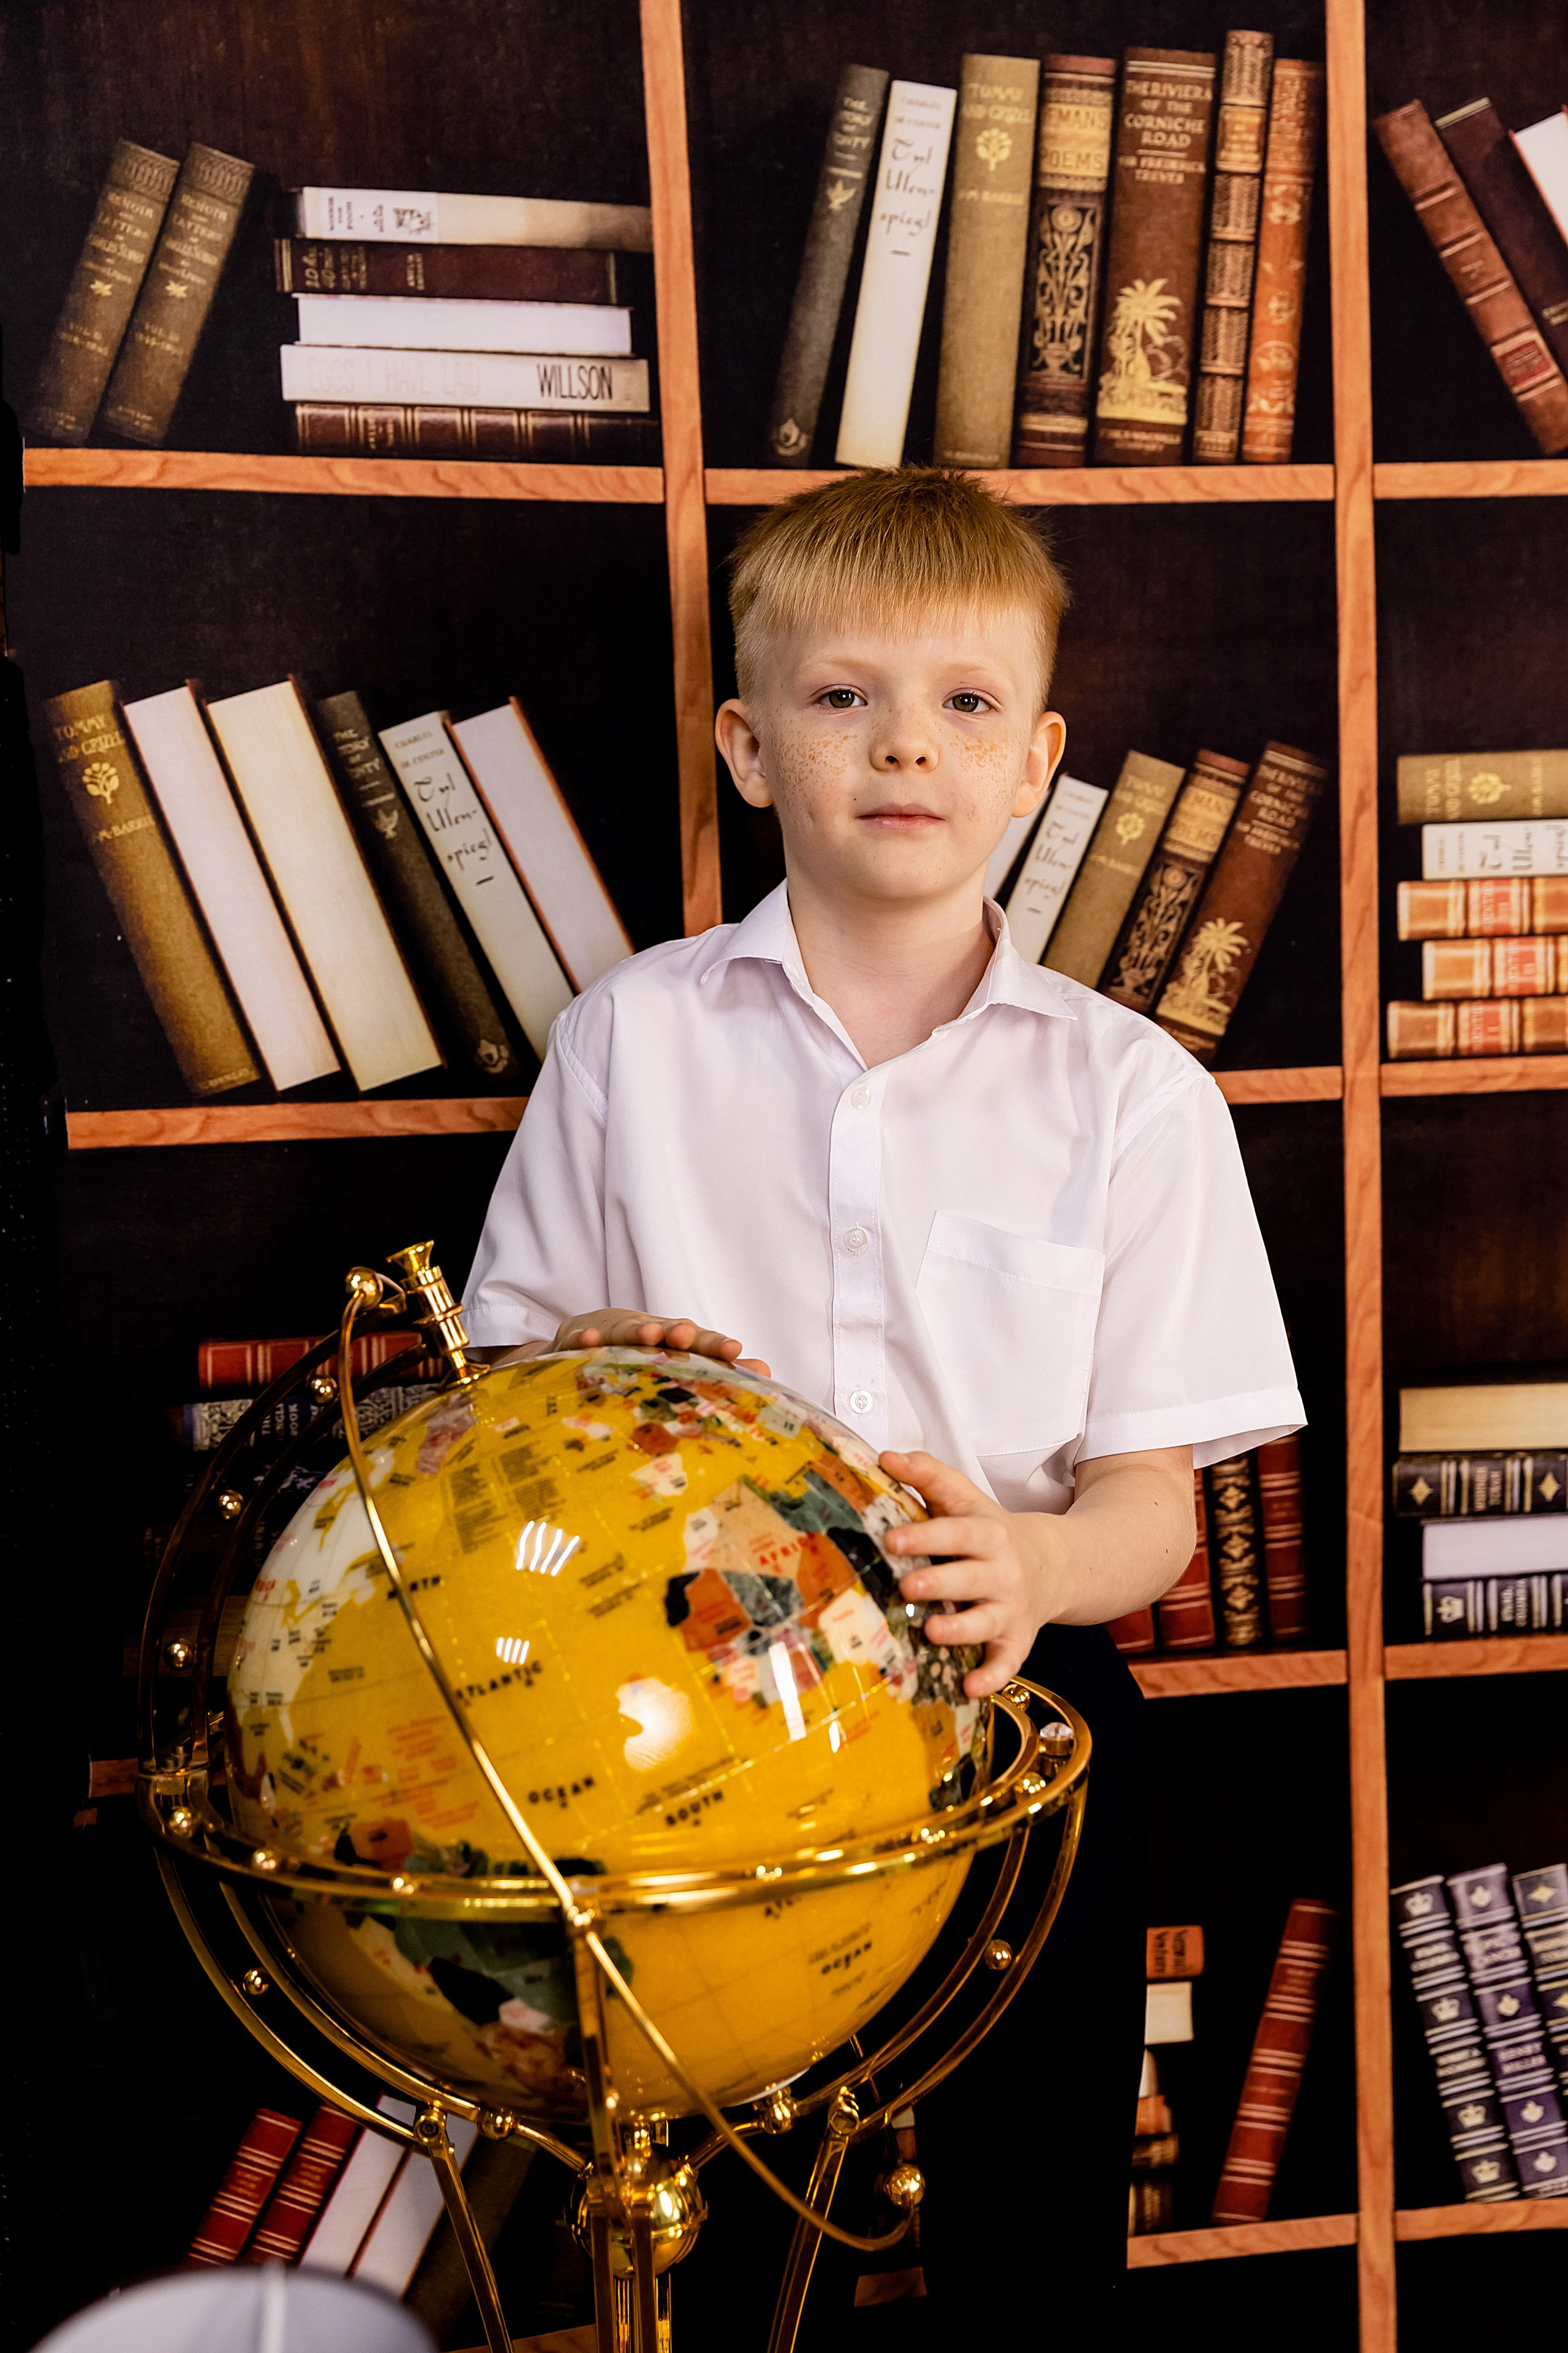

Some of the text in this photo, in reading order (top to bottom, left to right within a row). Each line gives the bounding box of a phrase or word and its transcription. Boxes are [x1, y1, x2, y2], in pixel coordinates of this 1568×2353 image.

[1150, 81, 1213, 101] RIVIERA
[1166, 100, 1193, 114] THE
[1125, 114, 1206, 134] CORNICHE
[1142, 131, 1191, 149] ROAD
[537, 364, 613, 399] WILLSON
[388, 1575, 440, 1600] NRTH
[456, 1660, 542, 1699] ATLANTIC
[528, 1775, 594, 1805] OCEAN
[665, 1791, 723, 1826] SOUTH
[821, 1941, 872, 1975] OCEAN
